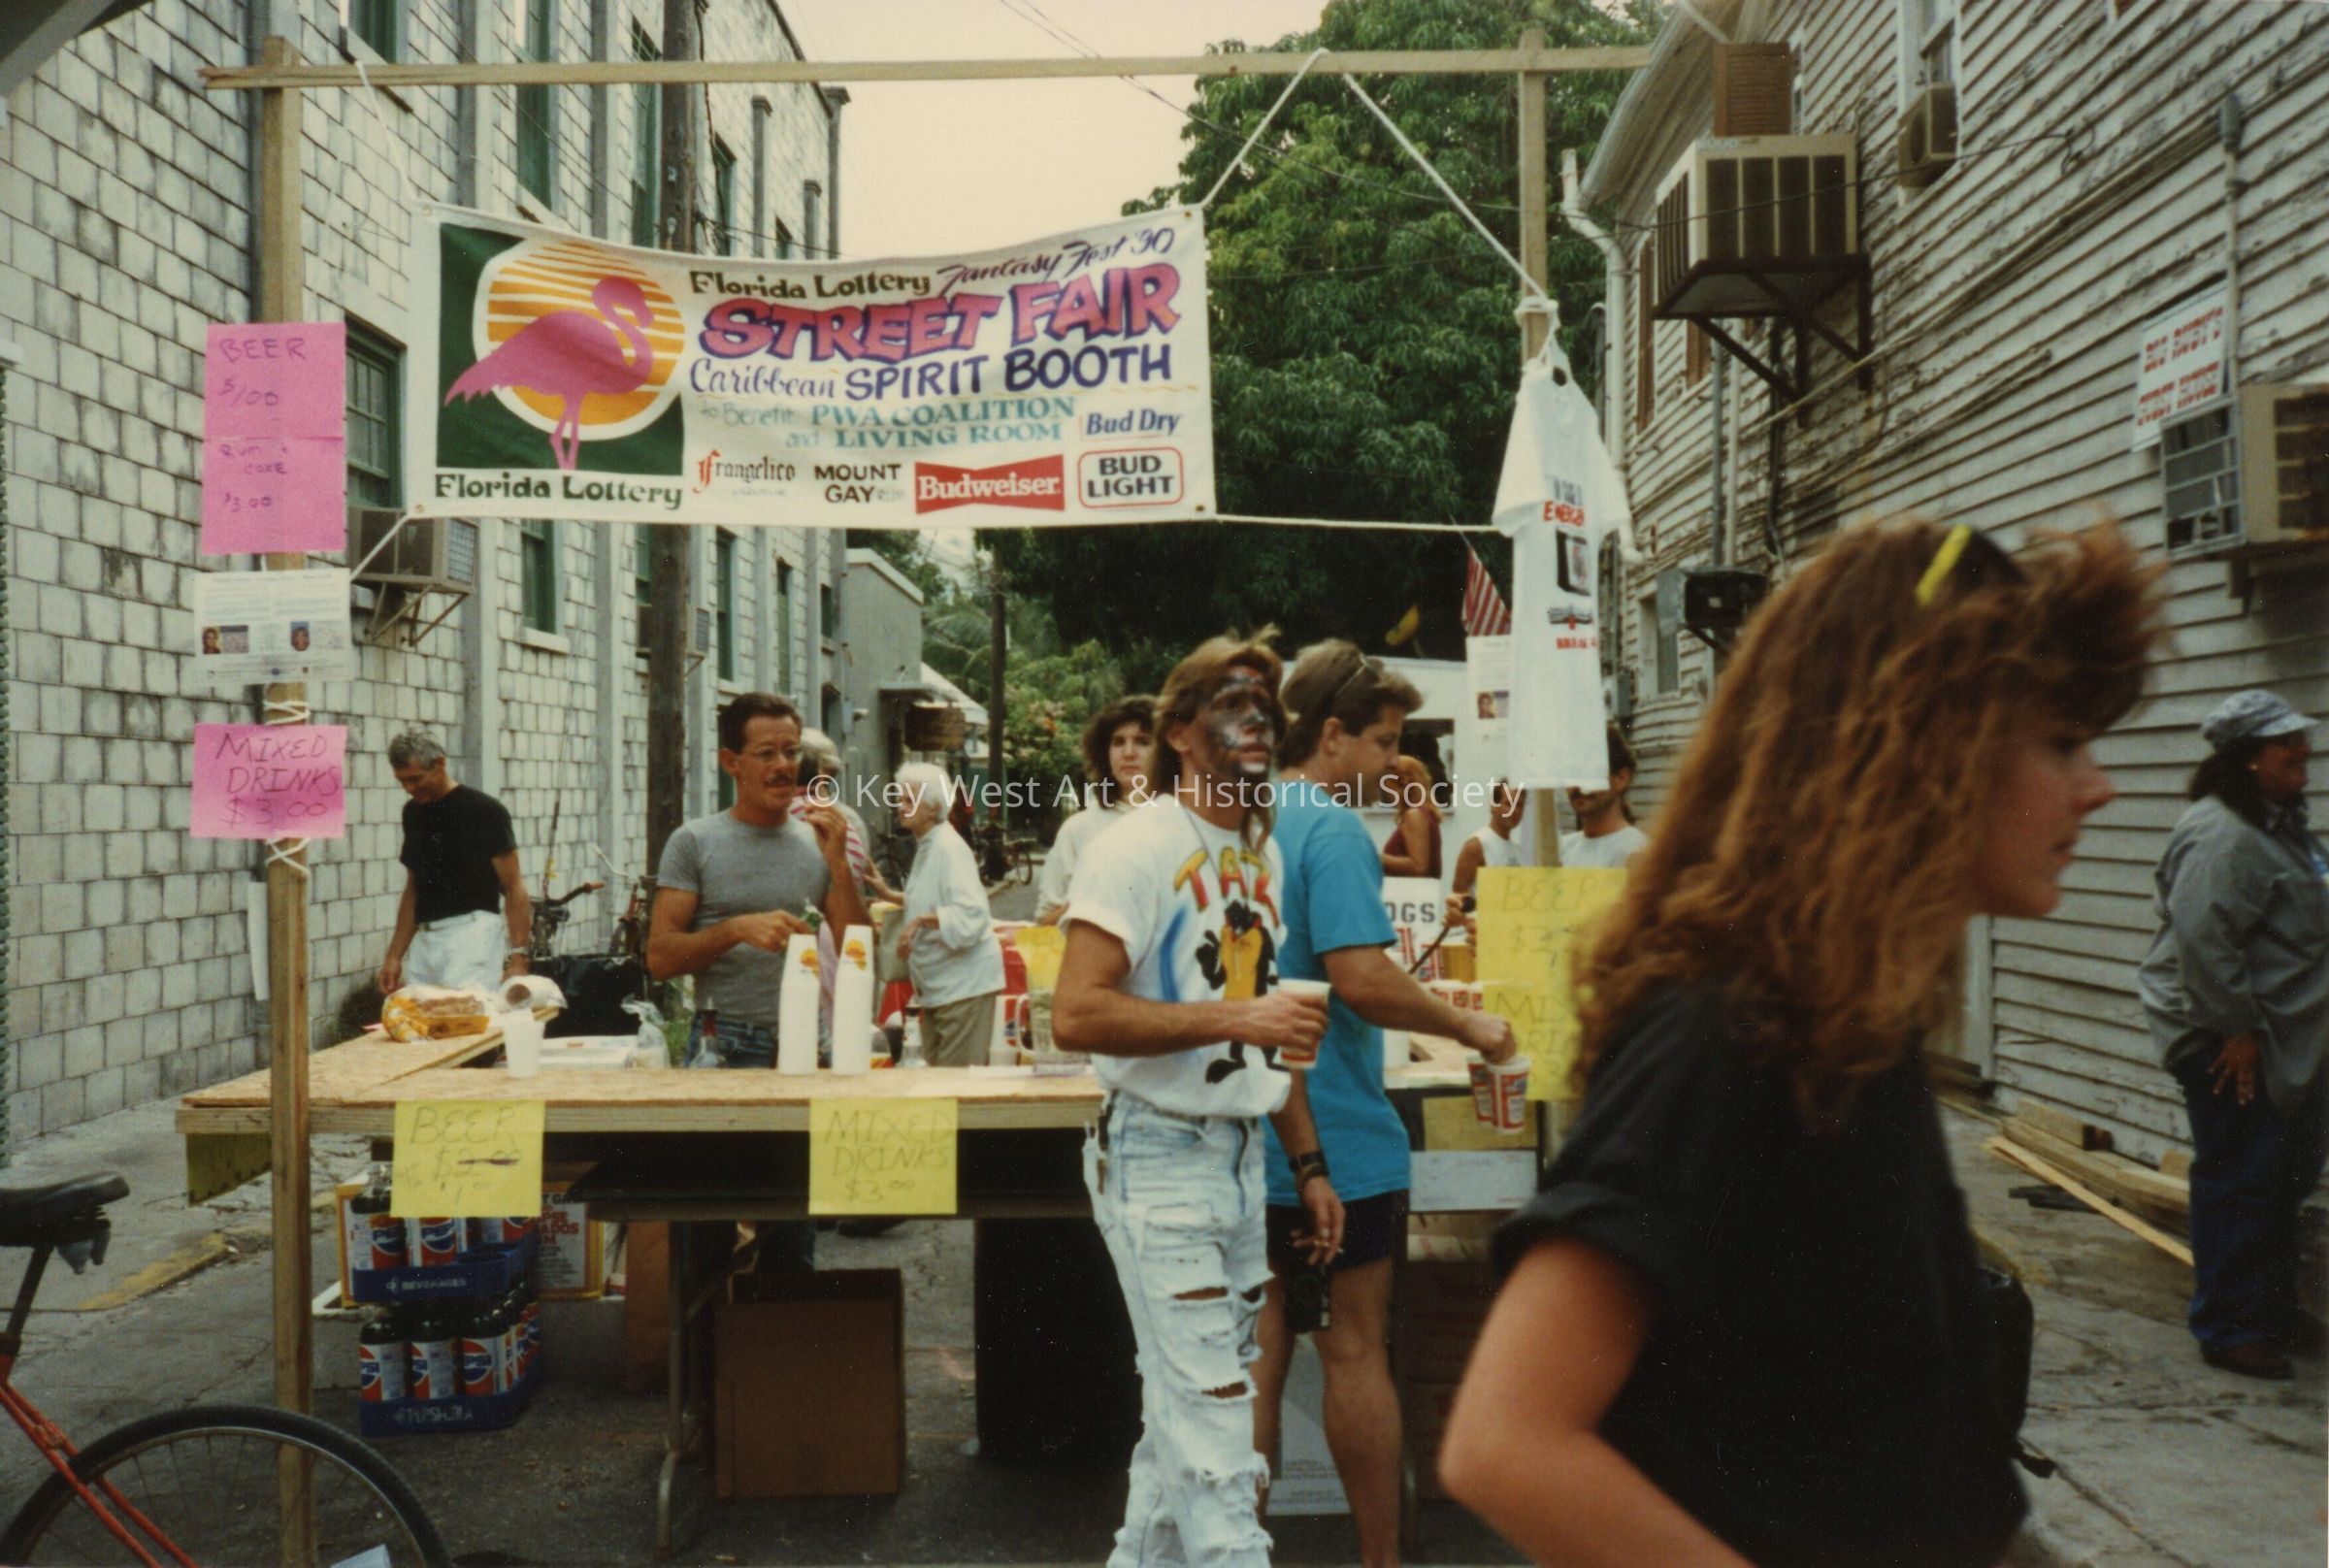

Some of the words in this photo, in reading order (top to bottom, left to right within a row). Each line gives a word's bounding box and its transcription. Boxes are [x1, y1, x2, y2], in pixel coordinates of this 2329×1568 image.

[689, 271, 807, 299] Florida
[813, 271, 930, 298] Lottery
[936, 251, 1065, 295] Fantasy
[1063, 235, 1128, 278] Fest
[699, 292, 1004, 365] STREET
[1007, 262, 1181, 347] FAIR
[220, 338, 306, 363] BEER
[690, 358, 835, 398] Caribbean
[845, 355, 989, 401] SPIRIT
[1003, 343, 1171, 392] BOOTH
[811, 404, 883, 427] PWA
[891, 396, 1075, 427] COALITION
[1087, 409, 1133, 435] Bud
[1139, 408, 1181, 436] Dry
[836, 424, 957, 448] LIVING
[970, 421, 1061, 444] ROOM
[814, 464, 902, 481] MOUNT
[1099, 455, 1162, 476] BUD
[435, 473, 551, 499] Florida
[563, 474, 684, 510] Lottery
[824, 484, 875, 504] GAY
[918, 472, 1061, 500] Budweiser
[1086, 475, 1174, 498] LIGHT
[215, 733, 327, 763] MIXED
[227, 766, 340, 797] DRINKS
[410, 1106, 515, 1147] BEER
[824, 1110, 952, 1145] MIXED
[832, 1145, 948, 1176] DRINKS
